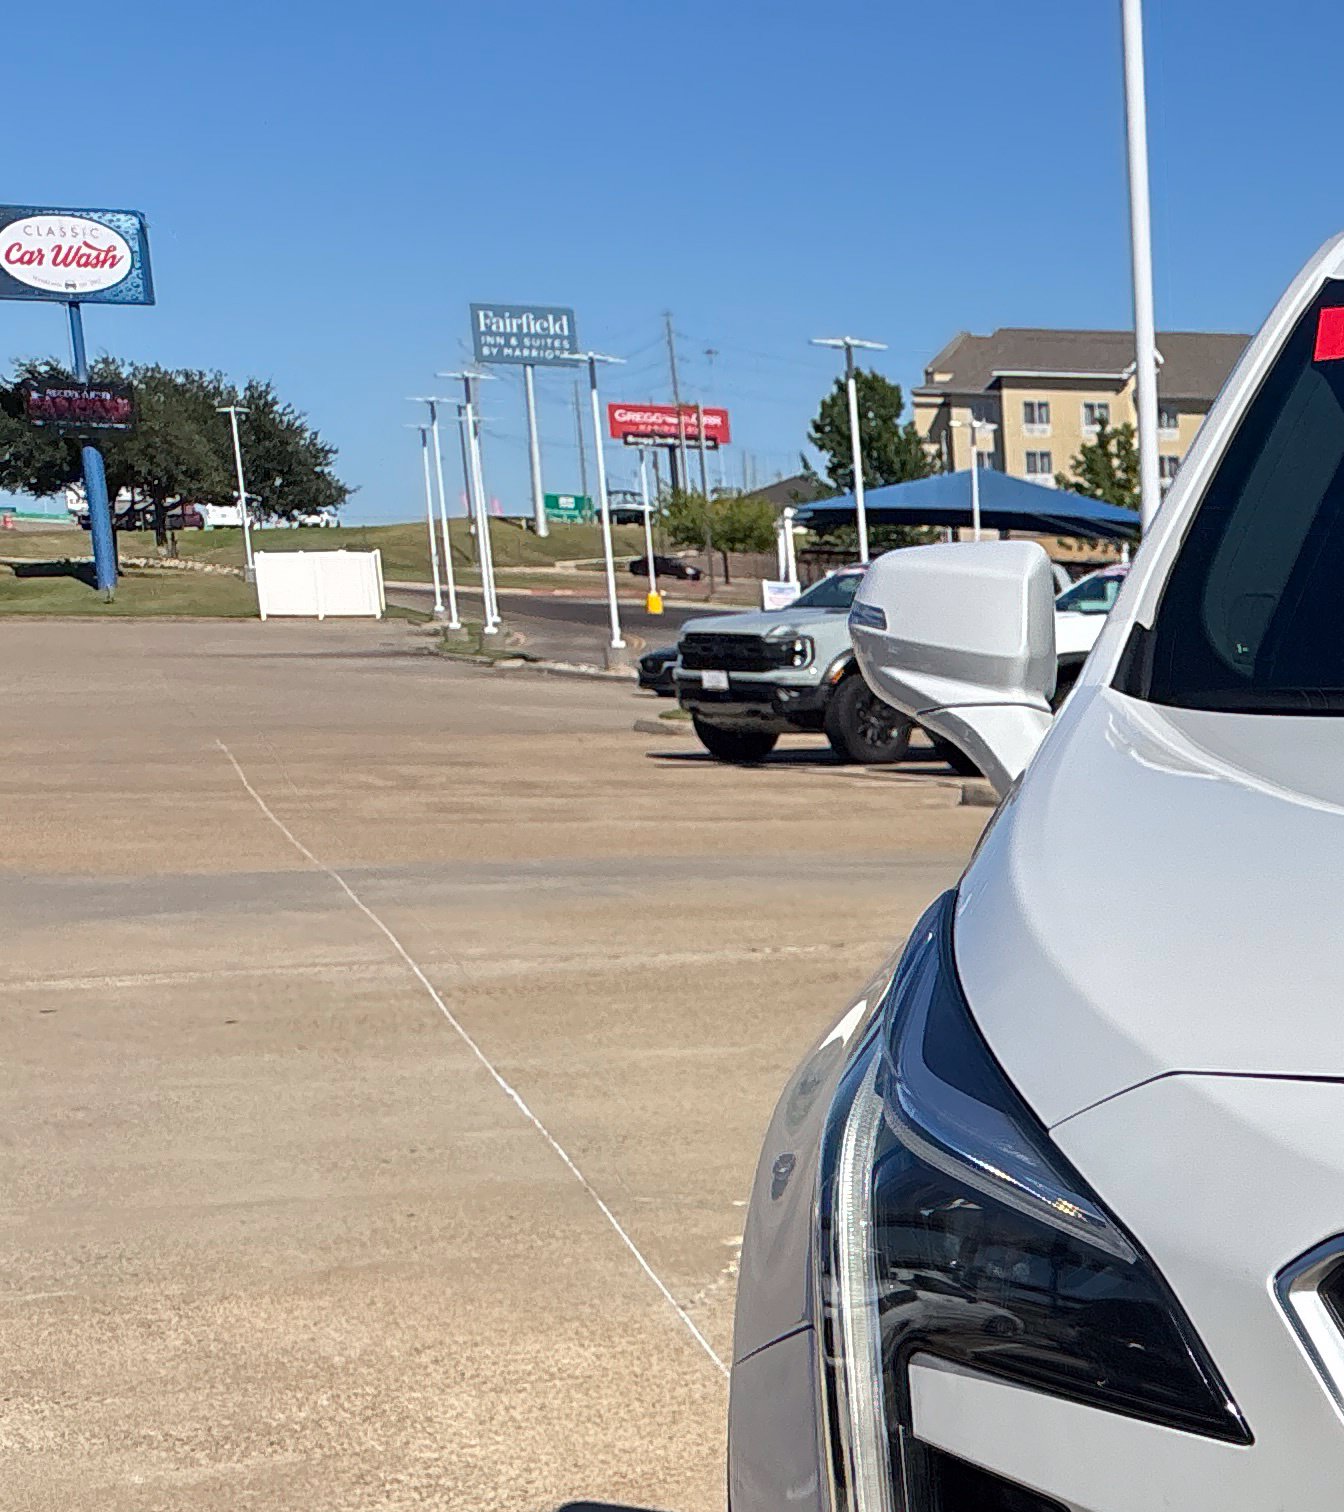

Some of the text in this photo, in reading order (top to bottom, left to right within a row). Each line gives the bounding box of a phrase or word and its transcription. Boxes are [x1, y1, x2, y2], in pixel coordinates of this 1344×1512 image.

[23, 224, 100, 239] CLASSIC
[4, 240, 124, 269] Car Wash
[477, 310, 569, 336] Fairfield
[480, 335, 570, 348] INN & SUITES
[482, 346, 498, 356] BY
